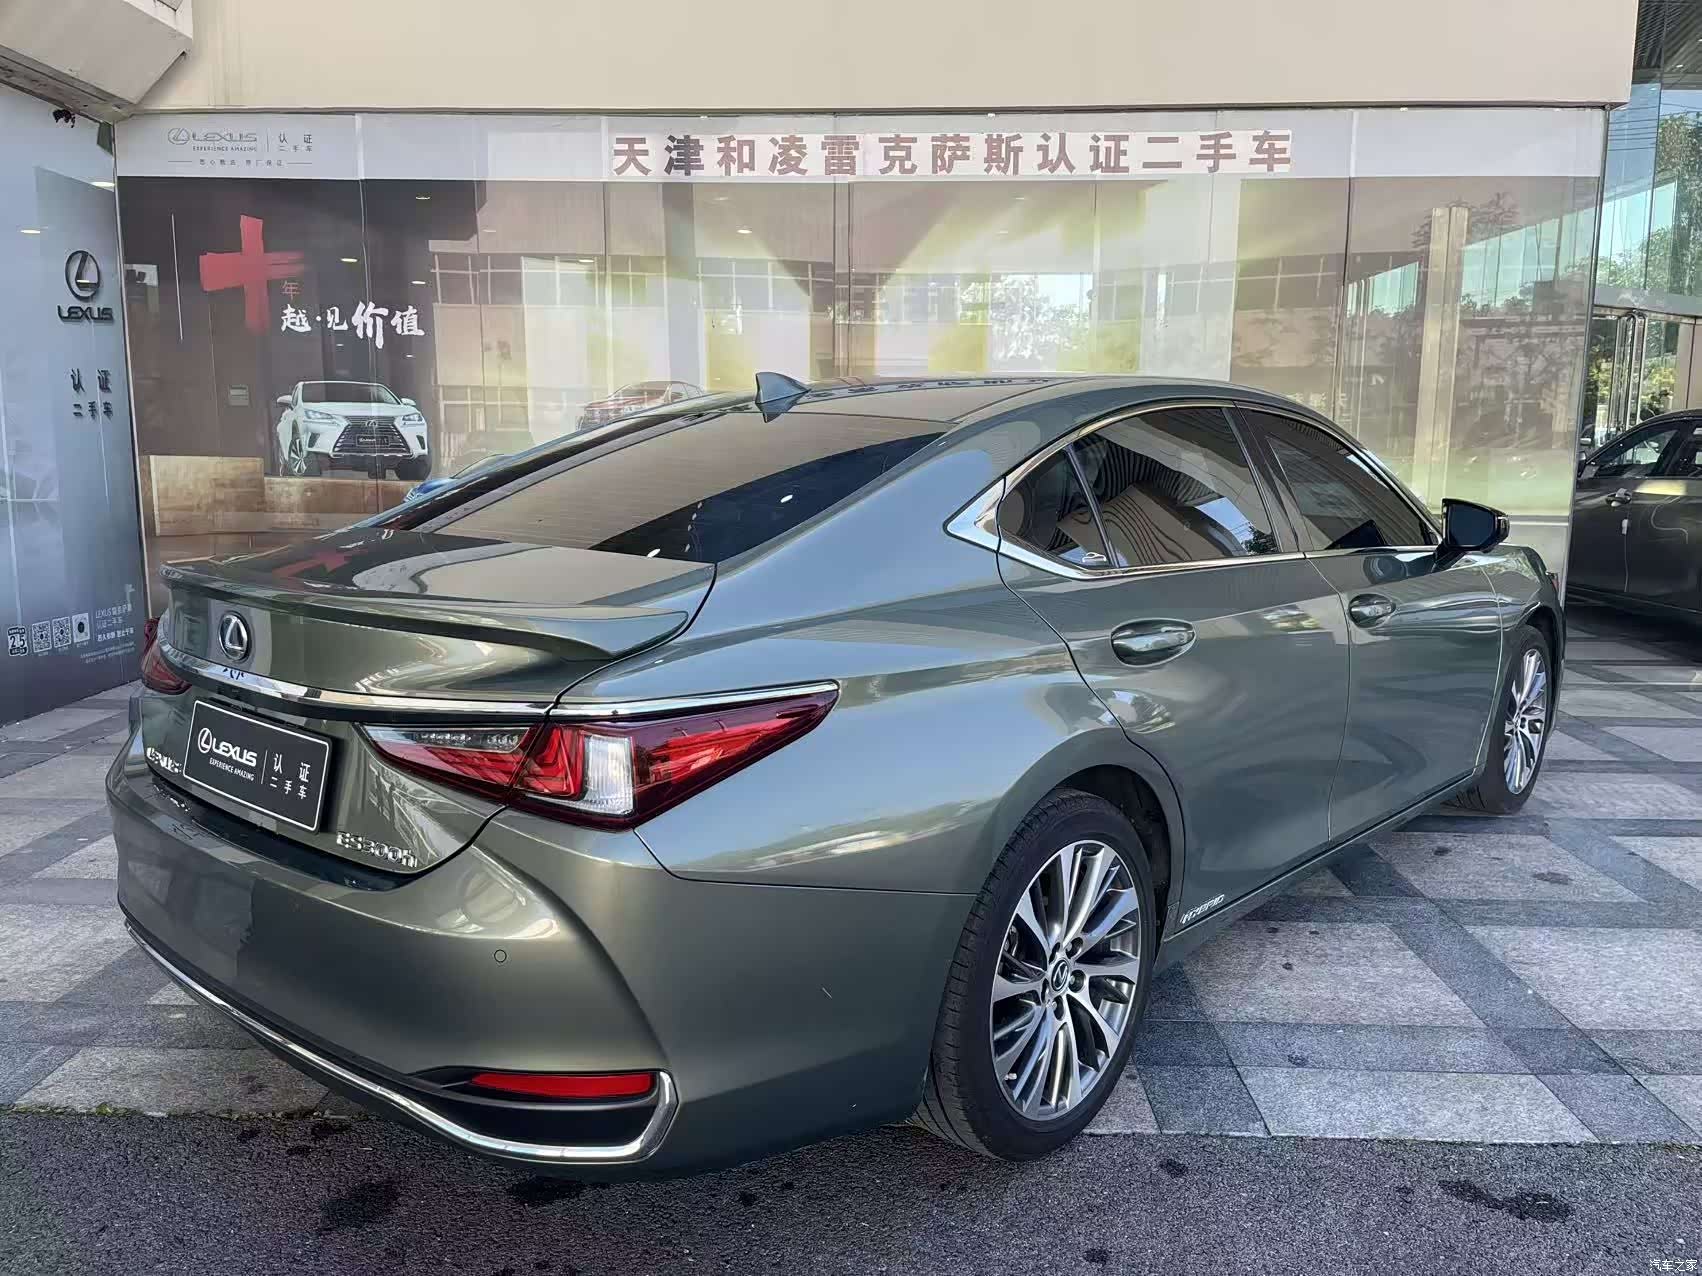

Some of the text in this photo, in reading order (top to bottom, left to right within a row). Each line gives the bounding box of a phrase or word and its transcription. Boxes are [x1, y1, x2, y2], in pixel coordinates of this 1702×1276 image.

[192, 132, 257, 143] LEXUS
[279, 133, 313, 144] 认证
[613, 130, 1292, 176] 天津和凌雷克萨斯认证二手车
[57, 305, 114, 321] LEXUS
[70, 368, 112, 394] 认证
[73, 401, 113, 420] 二手车
[212, 737, 257, 767] LEXUS
[209, 757, 255, 781] EXPERIENCE AMAZING
[273, 753, 311, 783] 认证
[270, 776, 307, 800] 二手车
